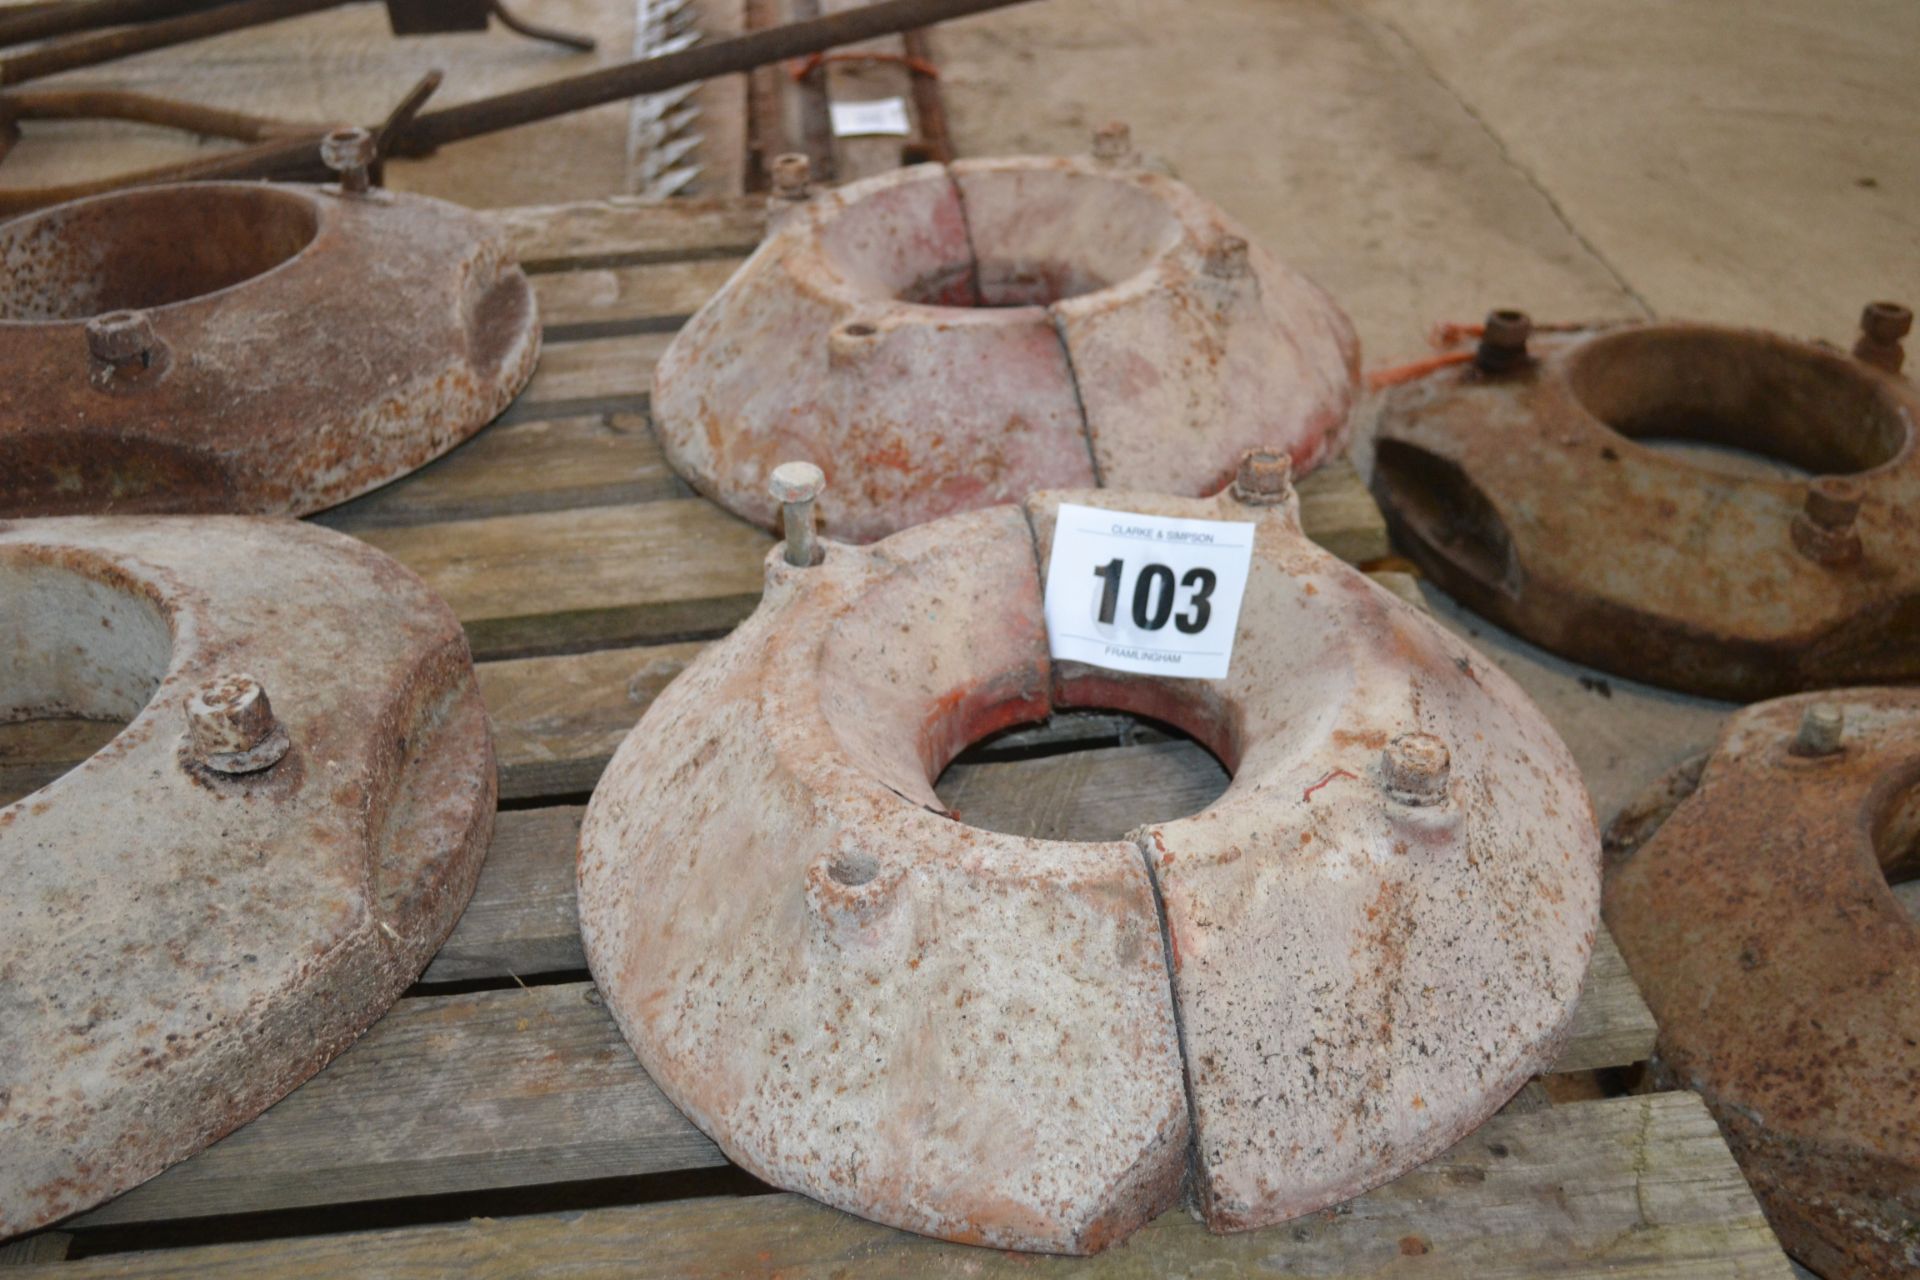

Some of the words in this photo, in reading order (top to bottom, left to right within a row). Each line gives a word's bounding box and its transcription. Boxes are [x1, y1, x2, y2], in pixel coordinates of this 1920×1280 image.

[1111, 524, 1153, 537] CLARKE
[1167, 531, 1214, 543] SIMPSON
[1094, 557, 1216, 635] 103
[1105, 645, 1181, 663] FRAMLINGHAM
